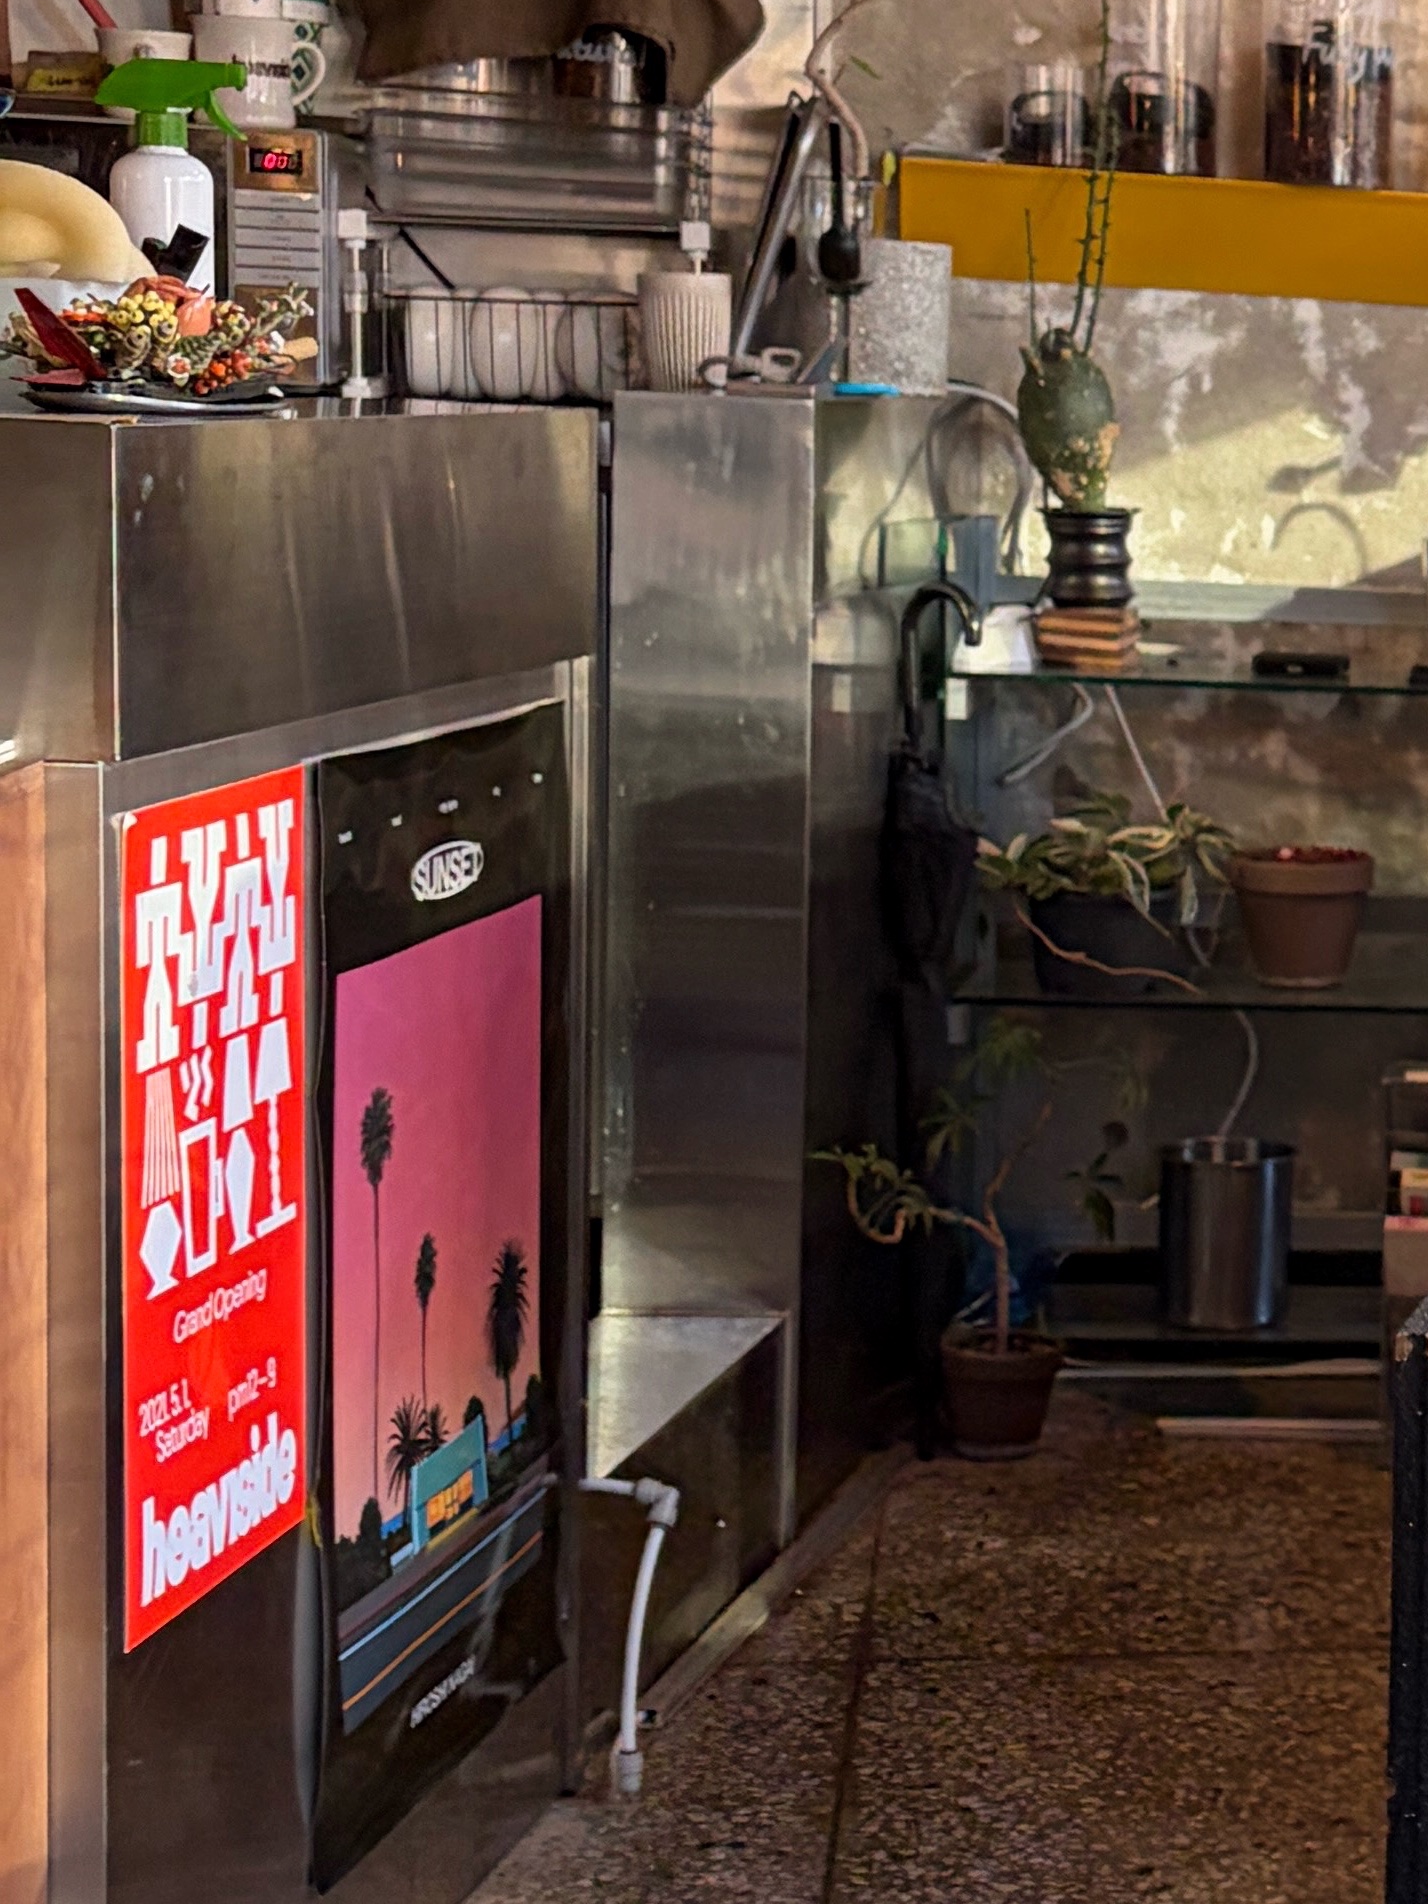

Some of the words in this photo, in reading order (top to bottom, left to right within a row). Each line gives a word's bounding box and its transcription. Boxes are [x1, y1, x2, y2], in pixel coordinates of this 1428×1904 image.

[412, 842, 485, 900] SUNSET
[172, 1291, 214, 1344] Grand
[213, 1268, 268, 1322] Opening
[154, 1406, 211, 1464] Saturday
[140, 1411, 298, 1608] heaviside
